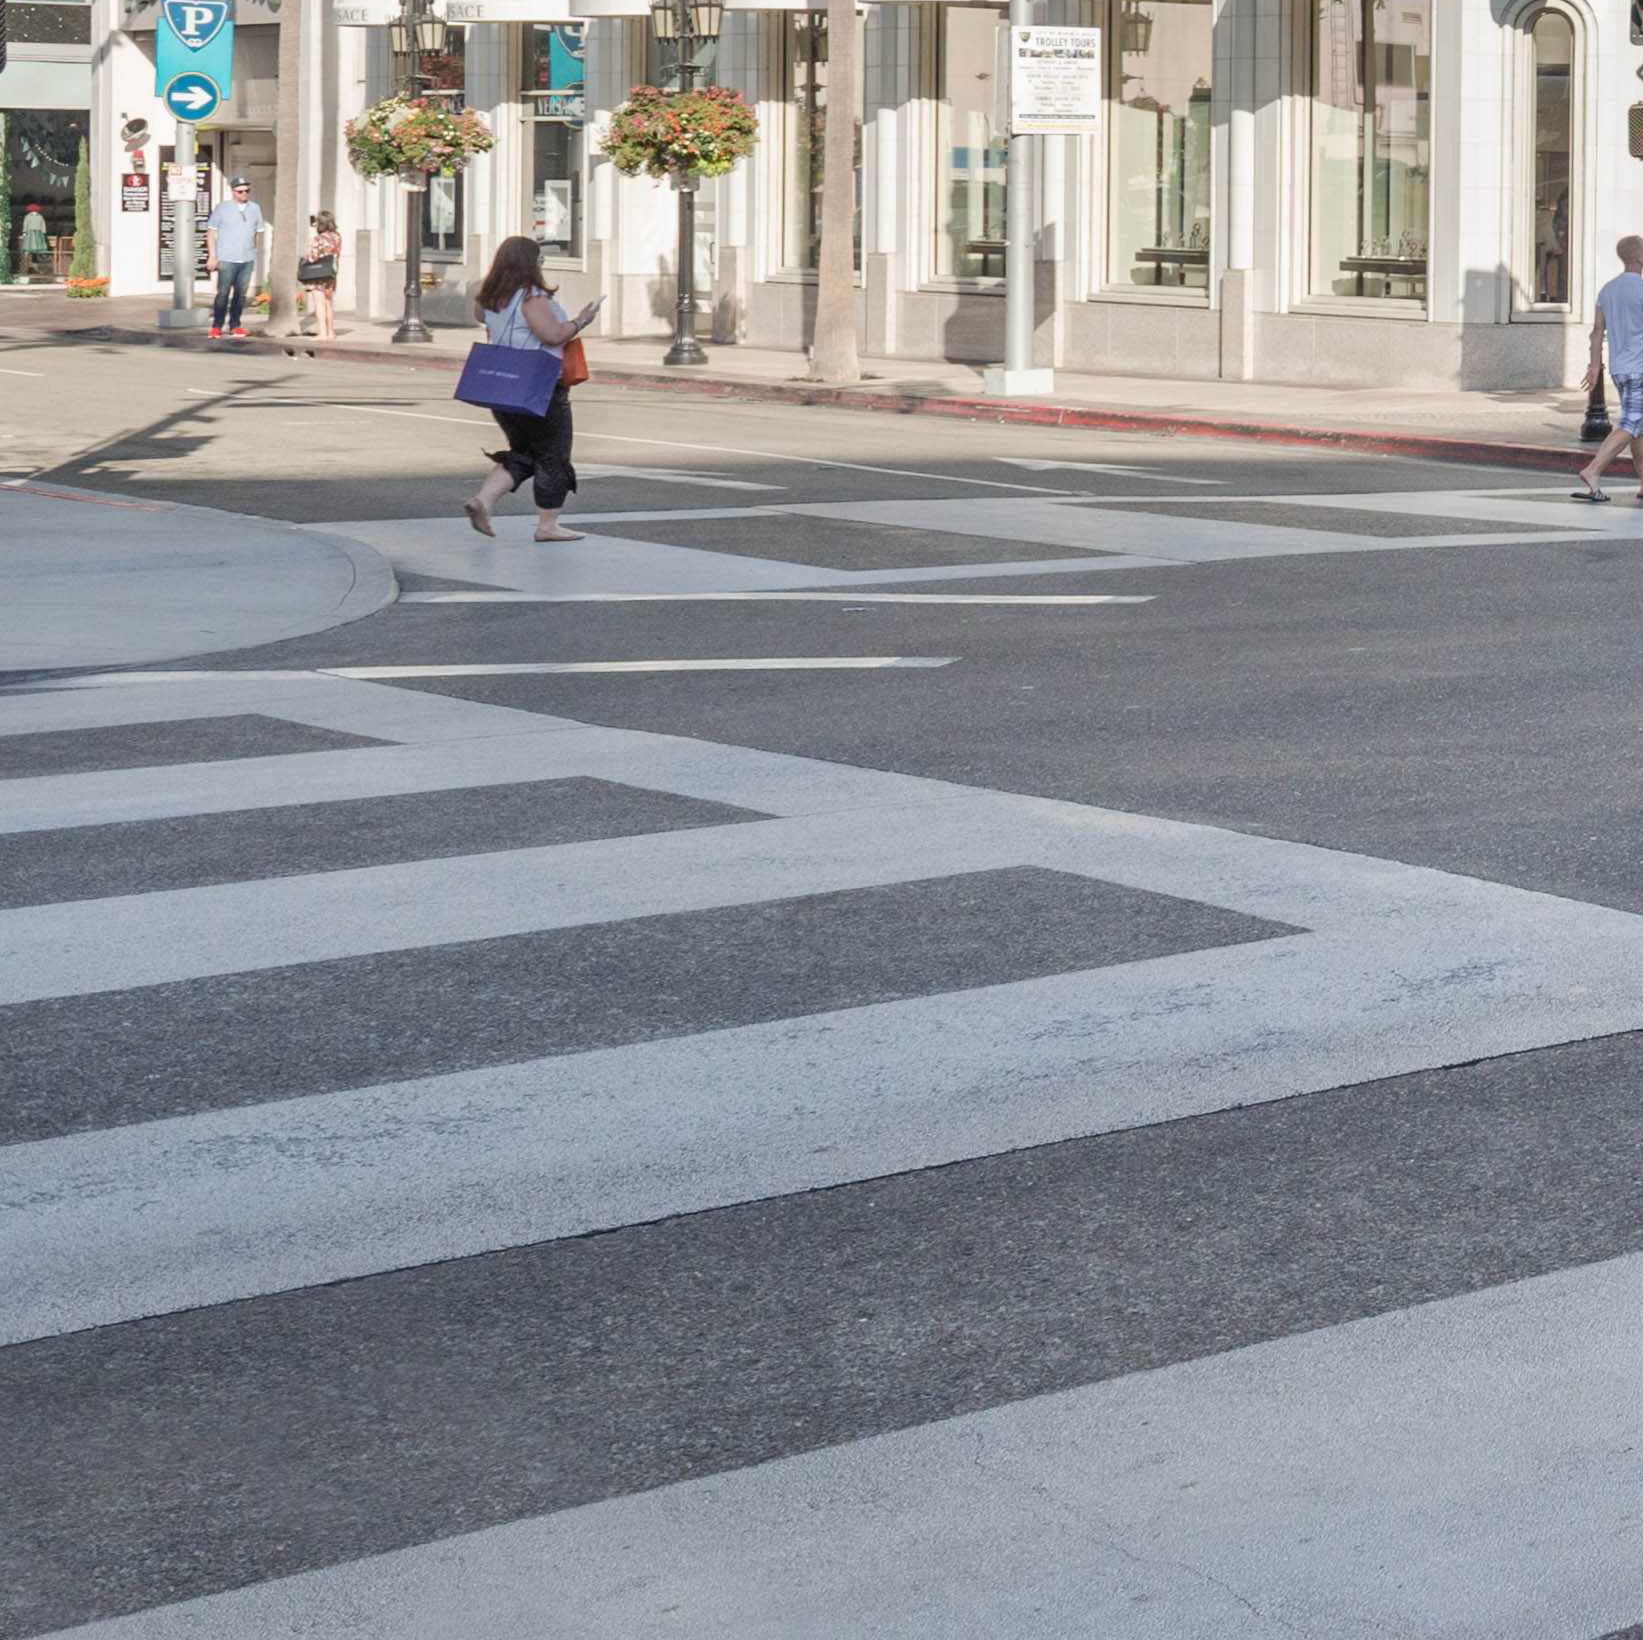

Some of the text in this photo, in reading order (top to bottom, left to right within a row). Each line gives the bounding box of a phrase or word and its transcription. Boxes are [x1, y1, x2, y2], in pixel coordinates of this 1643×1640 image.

[336, 8, 368, 22] SACE
[448, 4, 485, 18] SACE
[181, 6, 214, 35] P
[1035, 37, 1096, 48] TROLLEY TOURS
